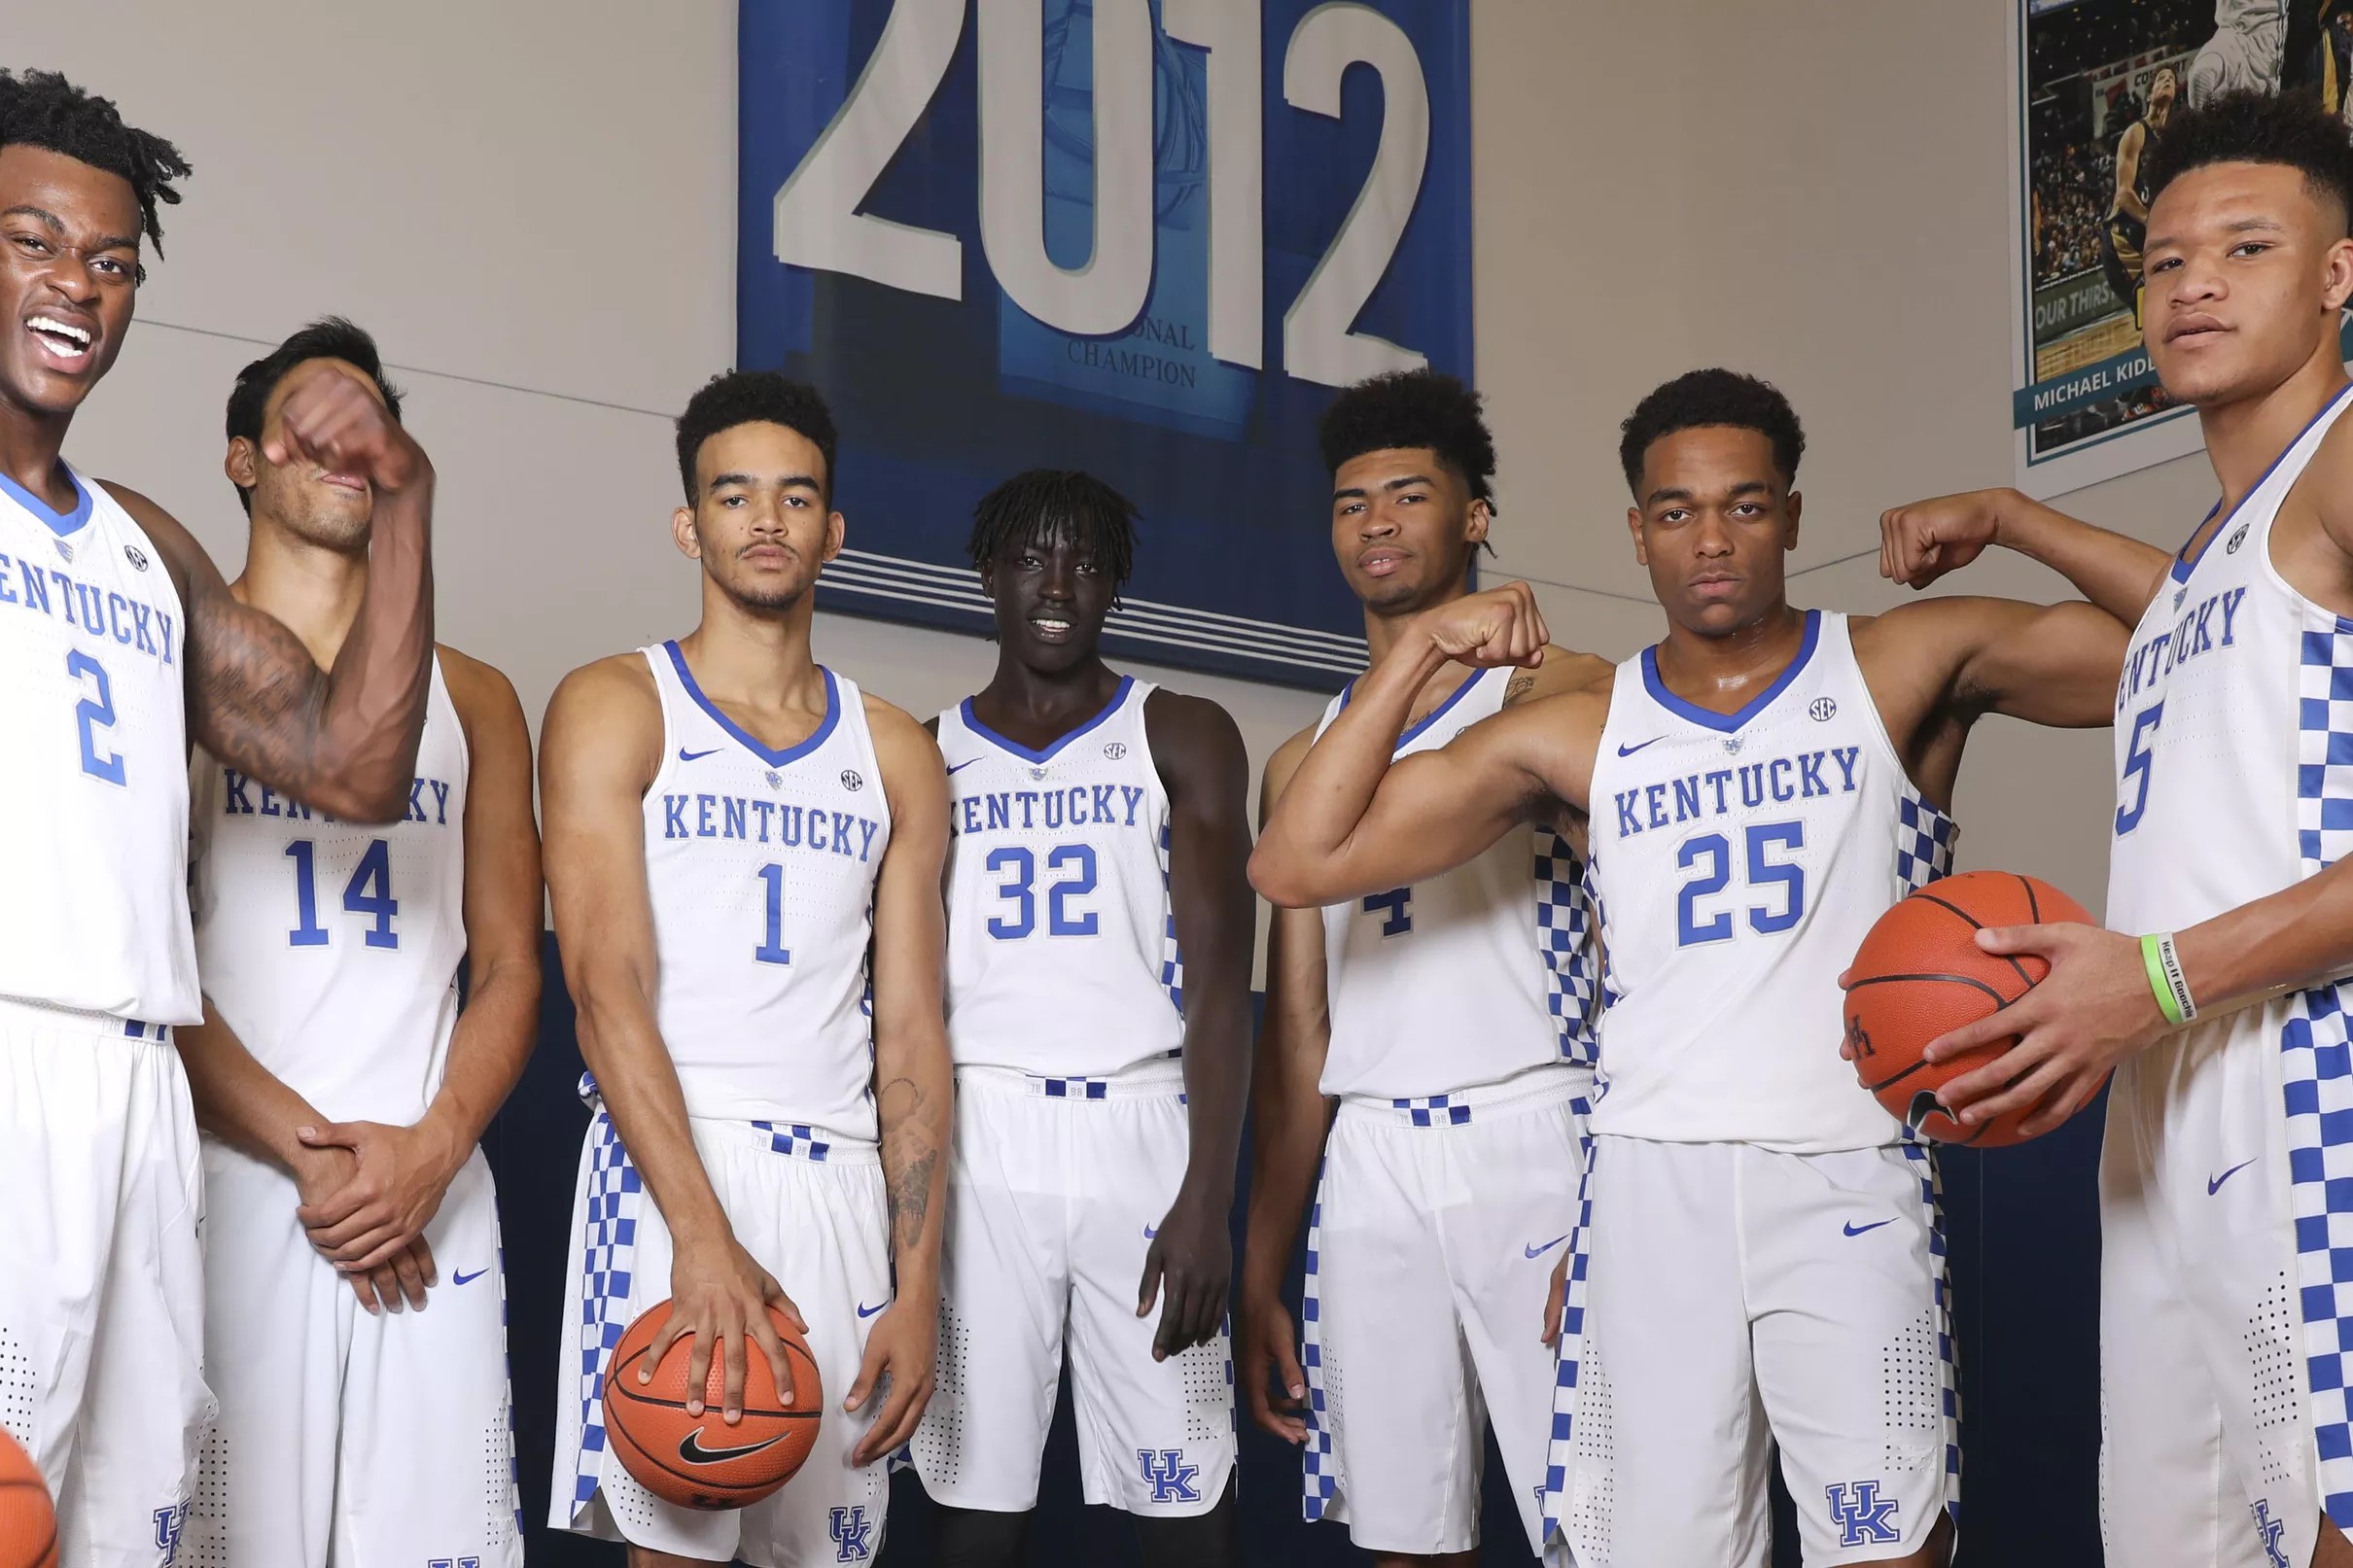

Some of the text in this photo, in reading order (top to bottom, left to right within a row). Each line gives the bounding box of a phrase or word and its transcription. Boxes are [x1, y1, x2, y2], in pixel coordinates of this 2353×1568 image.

[773, 0, 1429, 389] 2012
[1068, 341, 1195, 388] CHAMPION
[1134, 317, 1196, 350] ONAL
[2034, 371, 2111, 411] MICHAEL
[0, 553, 172, 665] ENTUCKY
[2119, 587, 2245, 712] ENTUCKY
[67, 648, 126, 786] 2
[1809, 697, 1836, 721] SEC
[841, 770, 863, 791] SEC
[1104, 742, 1127, 760] SEC
[2116, 699, 2165, 836] 5
[1614, 746, 1859, 838] KENTUCKY
[664, 793, 877, 863] KENTUCKY
[286, 839, 398, 949] 14
[755, 863, 790, 964] 1
[986, 843, 1099, 939] 32
[1677, 820, 1804, 947] 25
[2161, 941, 2174, 967] Keep
[1137, 1448, 1201, 1503] UK
[829, 1506, 872, 1562] UK
[1825, 1480, 1900, 1548] UK
